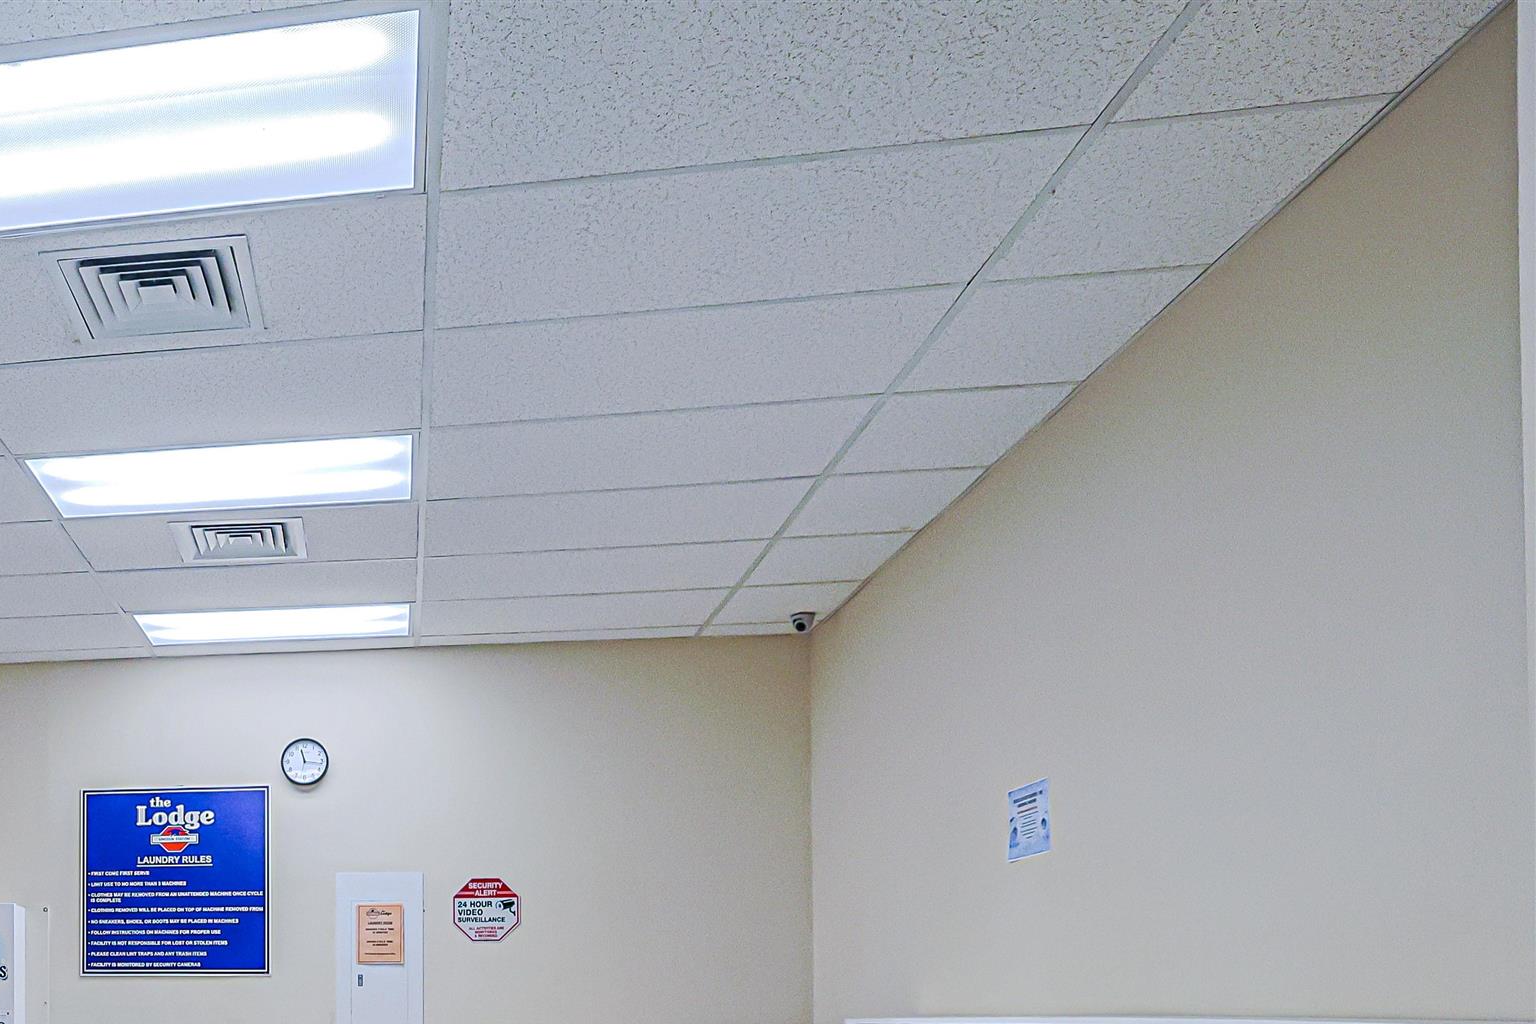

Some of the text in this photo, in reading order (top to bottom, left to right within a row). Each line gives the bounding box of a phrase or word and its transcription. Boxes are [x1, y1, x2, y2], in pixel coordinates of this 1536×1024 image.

[150, 797, 171, 807] the
[136, 804, 215, 830] Lodge
[137, 855, 212, 864] LAUNDRY RULES
